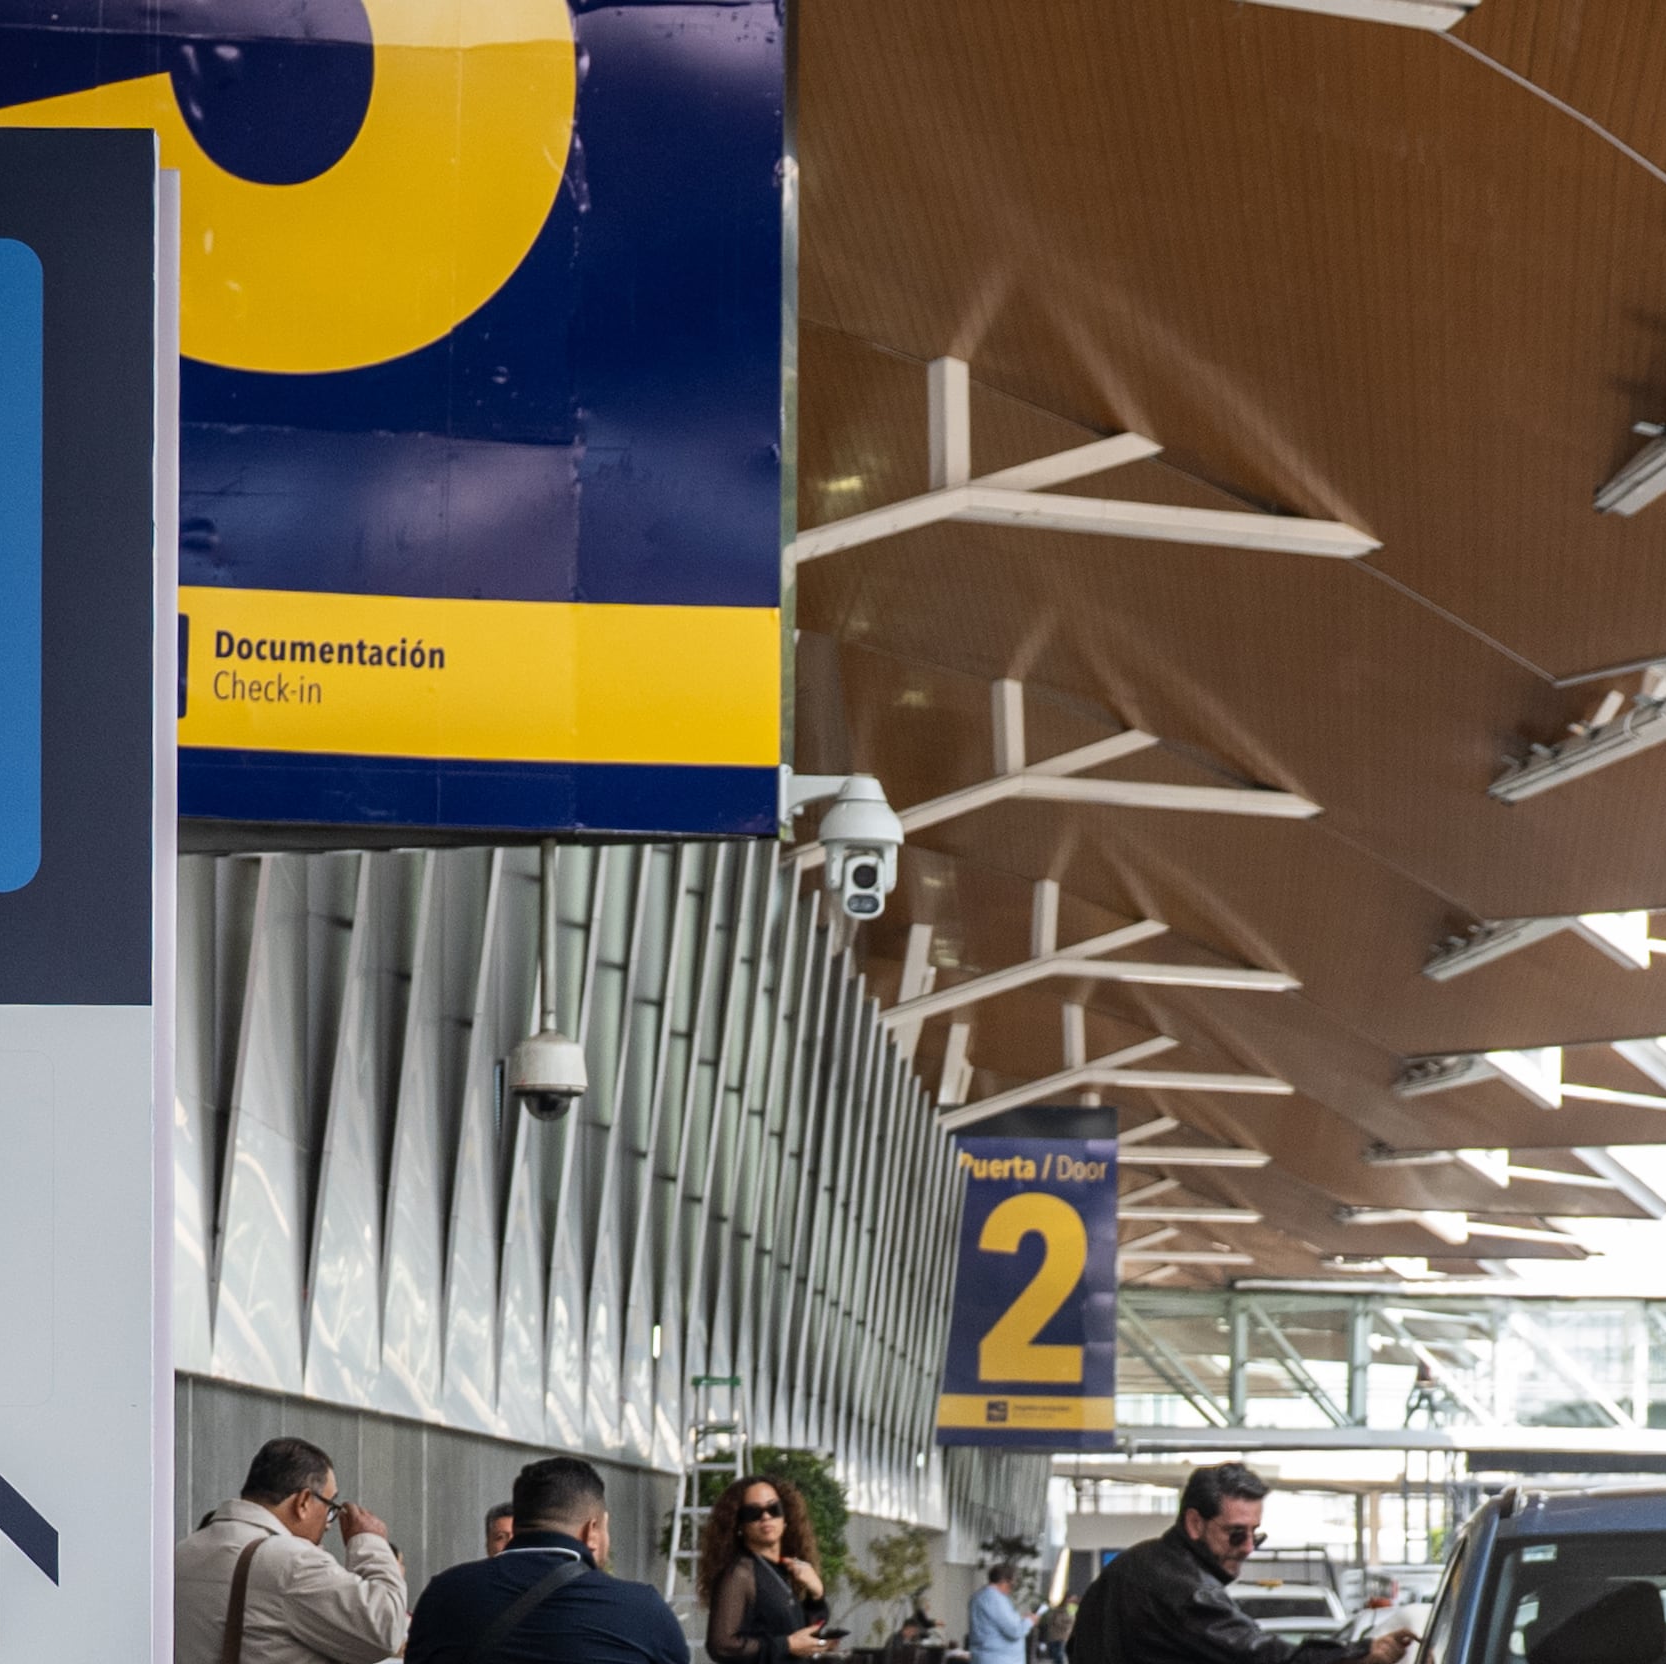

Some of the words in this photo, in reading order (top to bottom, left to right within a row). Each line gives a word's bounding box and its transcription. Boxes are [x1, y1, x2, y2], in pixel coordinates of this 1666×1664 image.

[215, 630, 445, 669] Documentación
[214, 670, 321, 704] Check-in
[1056, 1154, 1107, 1181] Door
[978, 1192, 1087, 1383] 2
